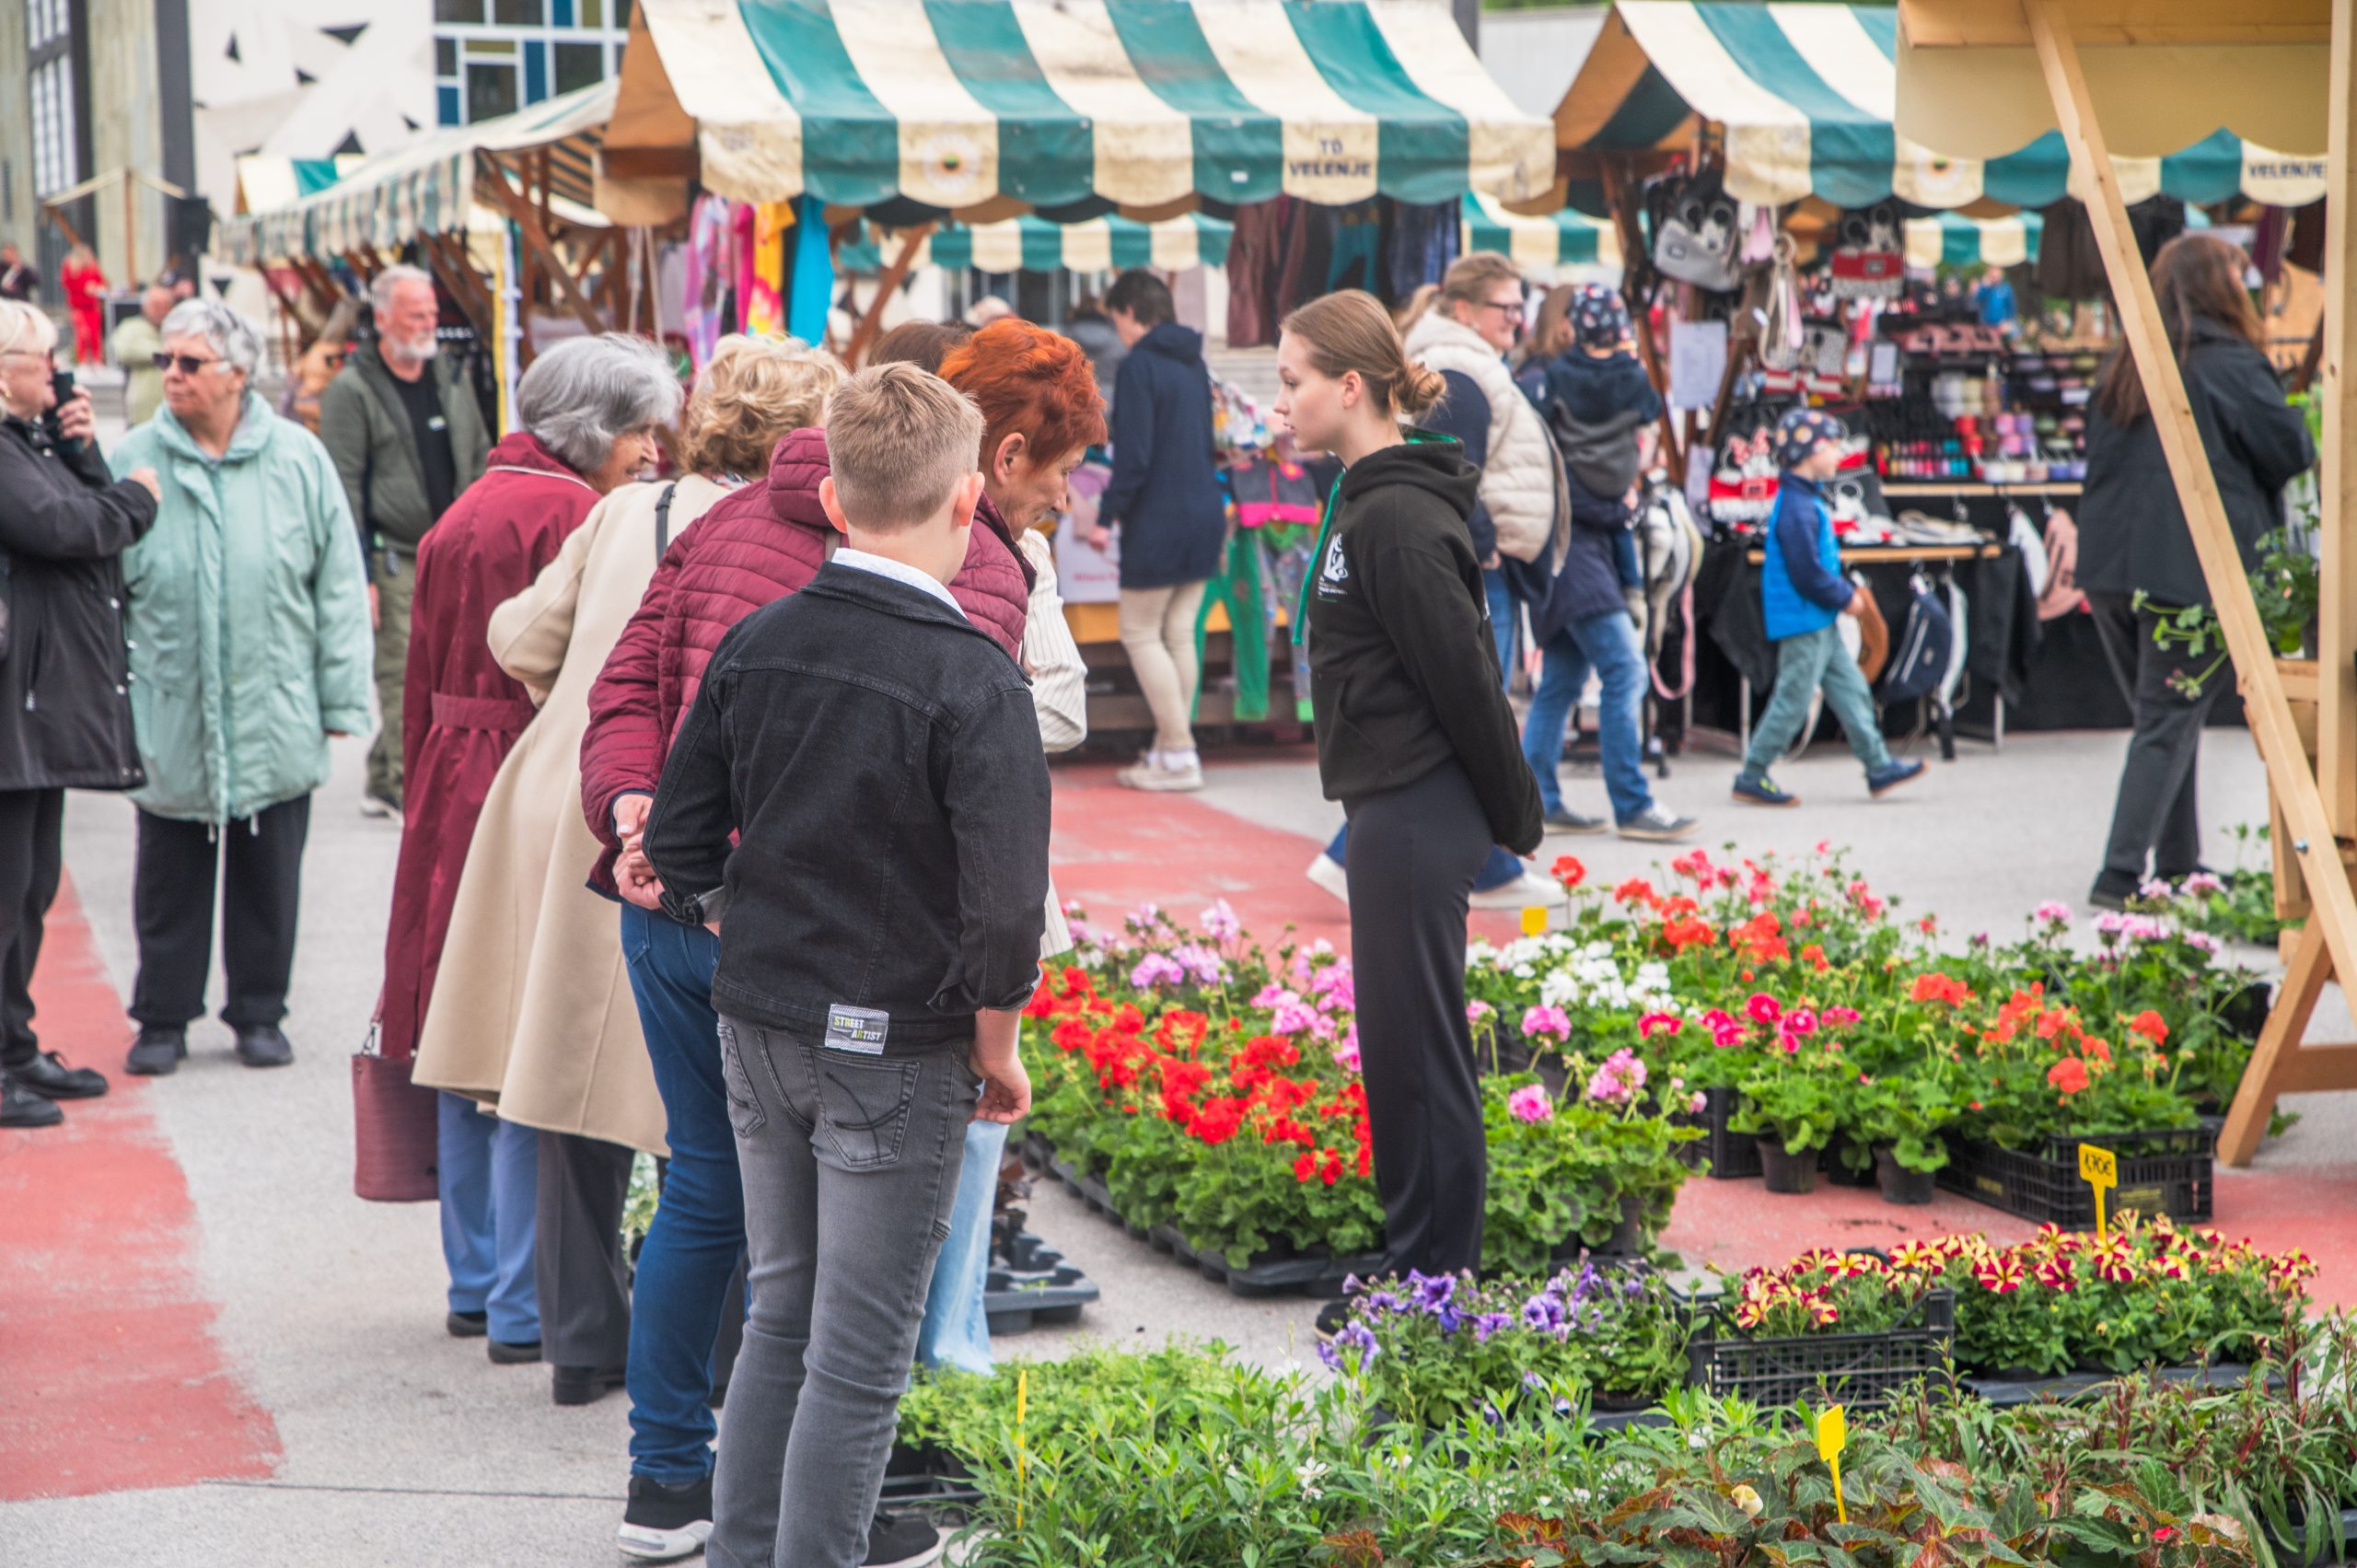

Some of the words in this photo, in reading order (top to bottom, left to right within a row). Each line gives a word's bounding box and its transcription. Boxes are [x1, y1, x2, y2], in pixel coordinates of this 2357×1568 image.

[1318, 138, 1343, 155] TD
[1289, 160, 1371, 176] VELENJE
[833, 1016, 865, 1029] STREET
[851, 1028, 882, 1041] ARTIST
